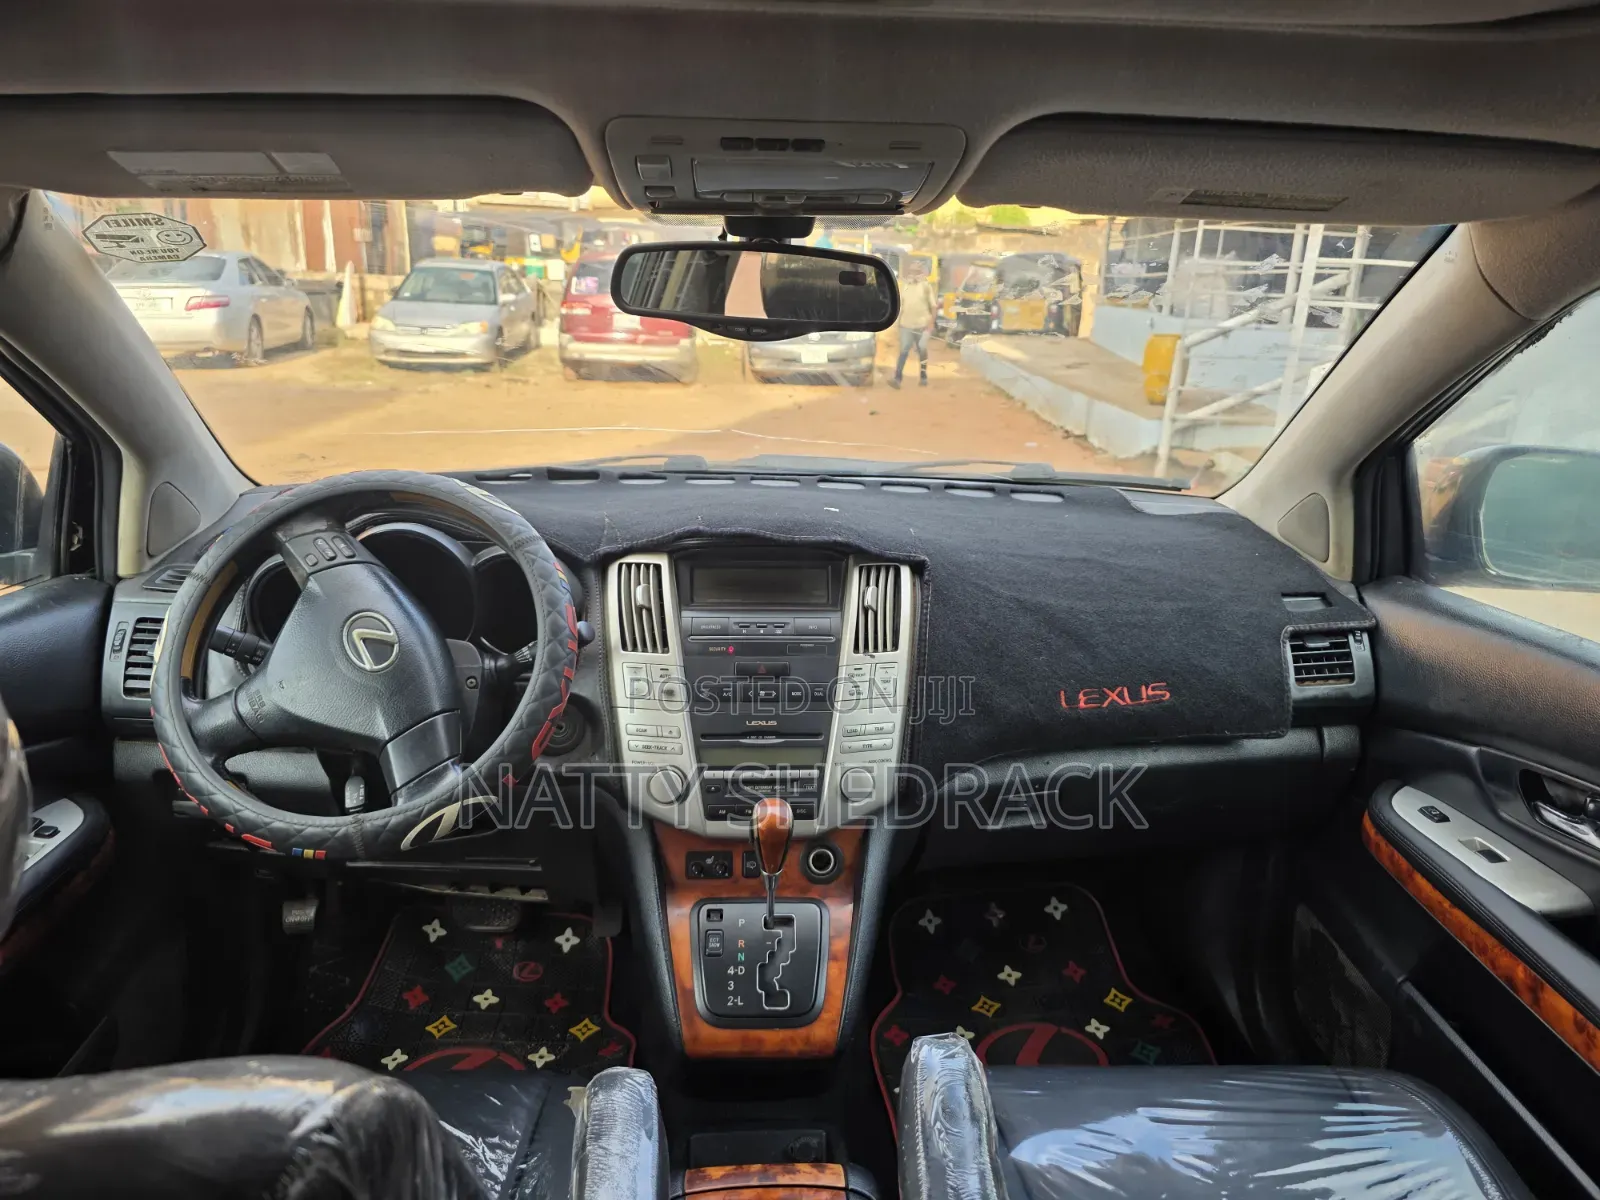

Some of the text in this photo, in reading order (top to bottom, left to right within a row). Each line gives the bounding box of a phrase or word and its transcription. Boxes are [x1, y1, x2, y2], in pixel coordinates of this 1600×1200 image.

[1060, 682, 1171, 709] LEXUS
[738, 919, 746, 927] P
[738, 940, 745, 948] R
[737, 952, 745, 961] N
[727, 965, 746, 976] 4-D
[727, 981, 735, 991] 3
[727, 996, 744, 1006] 2-L
